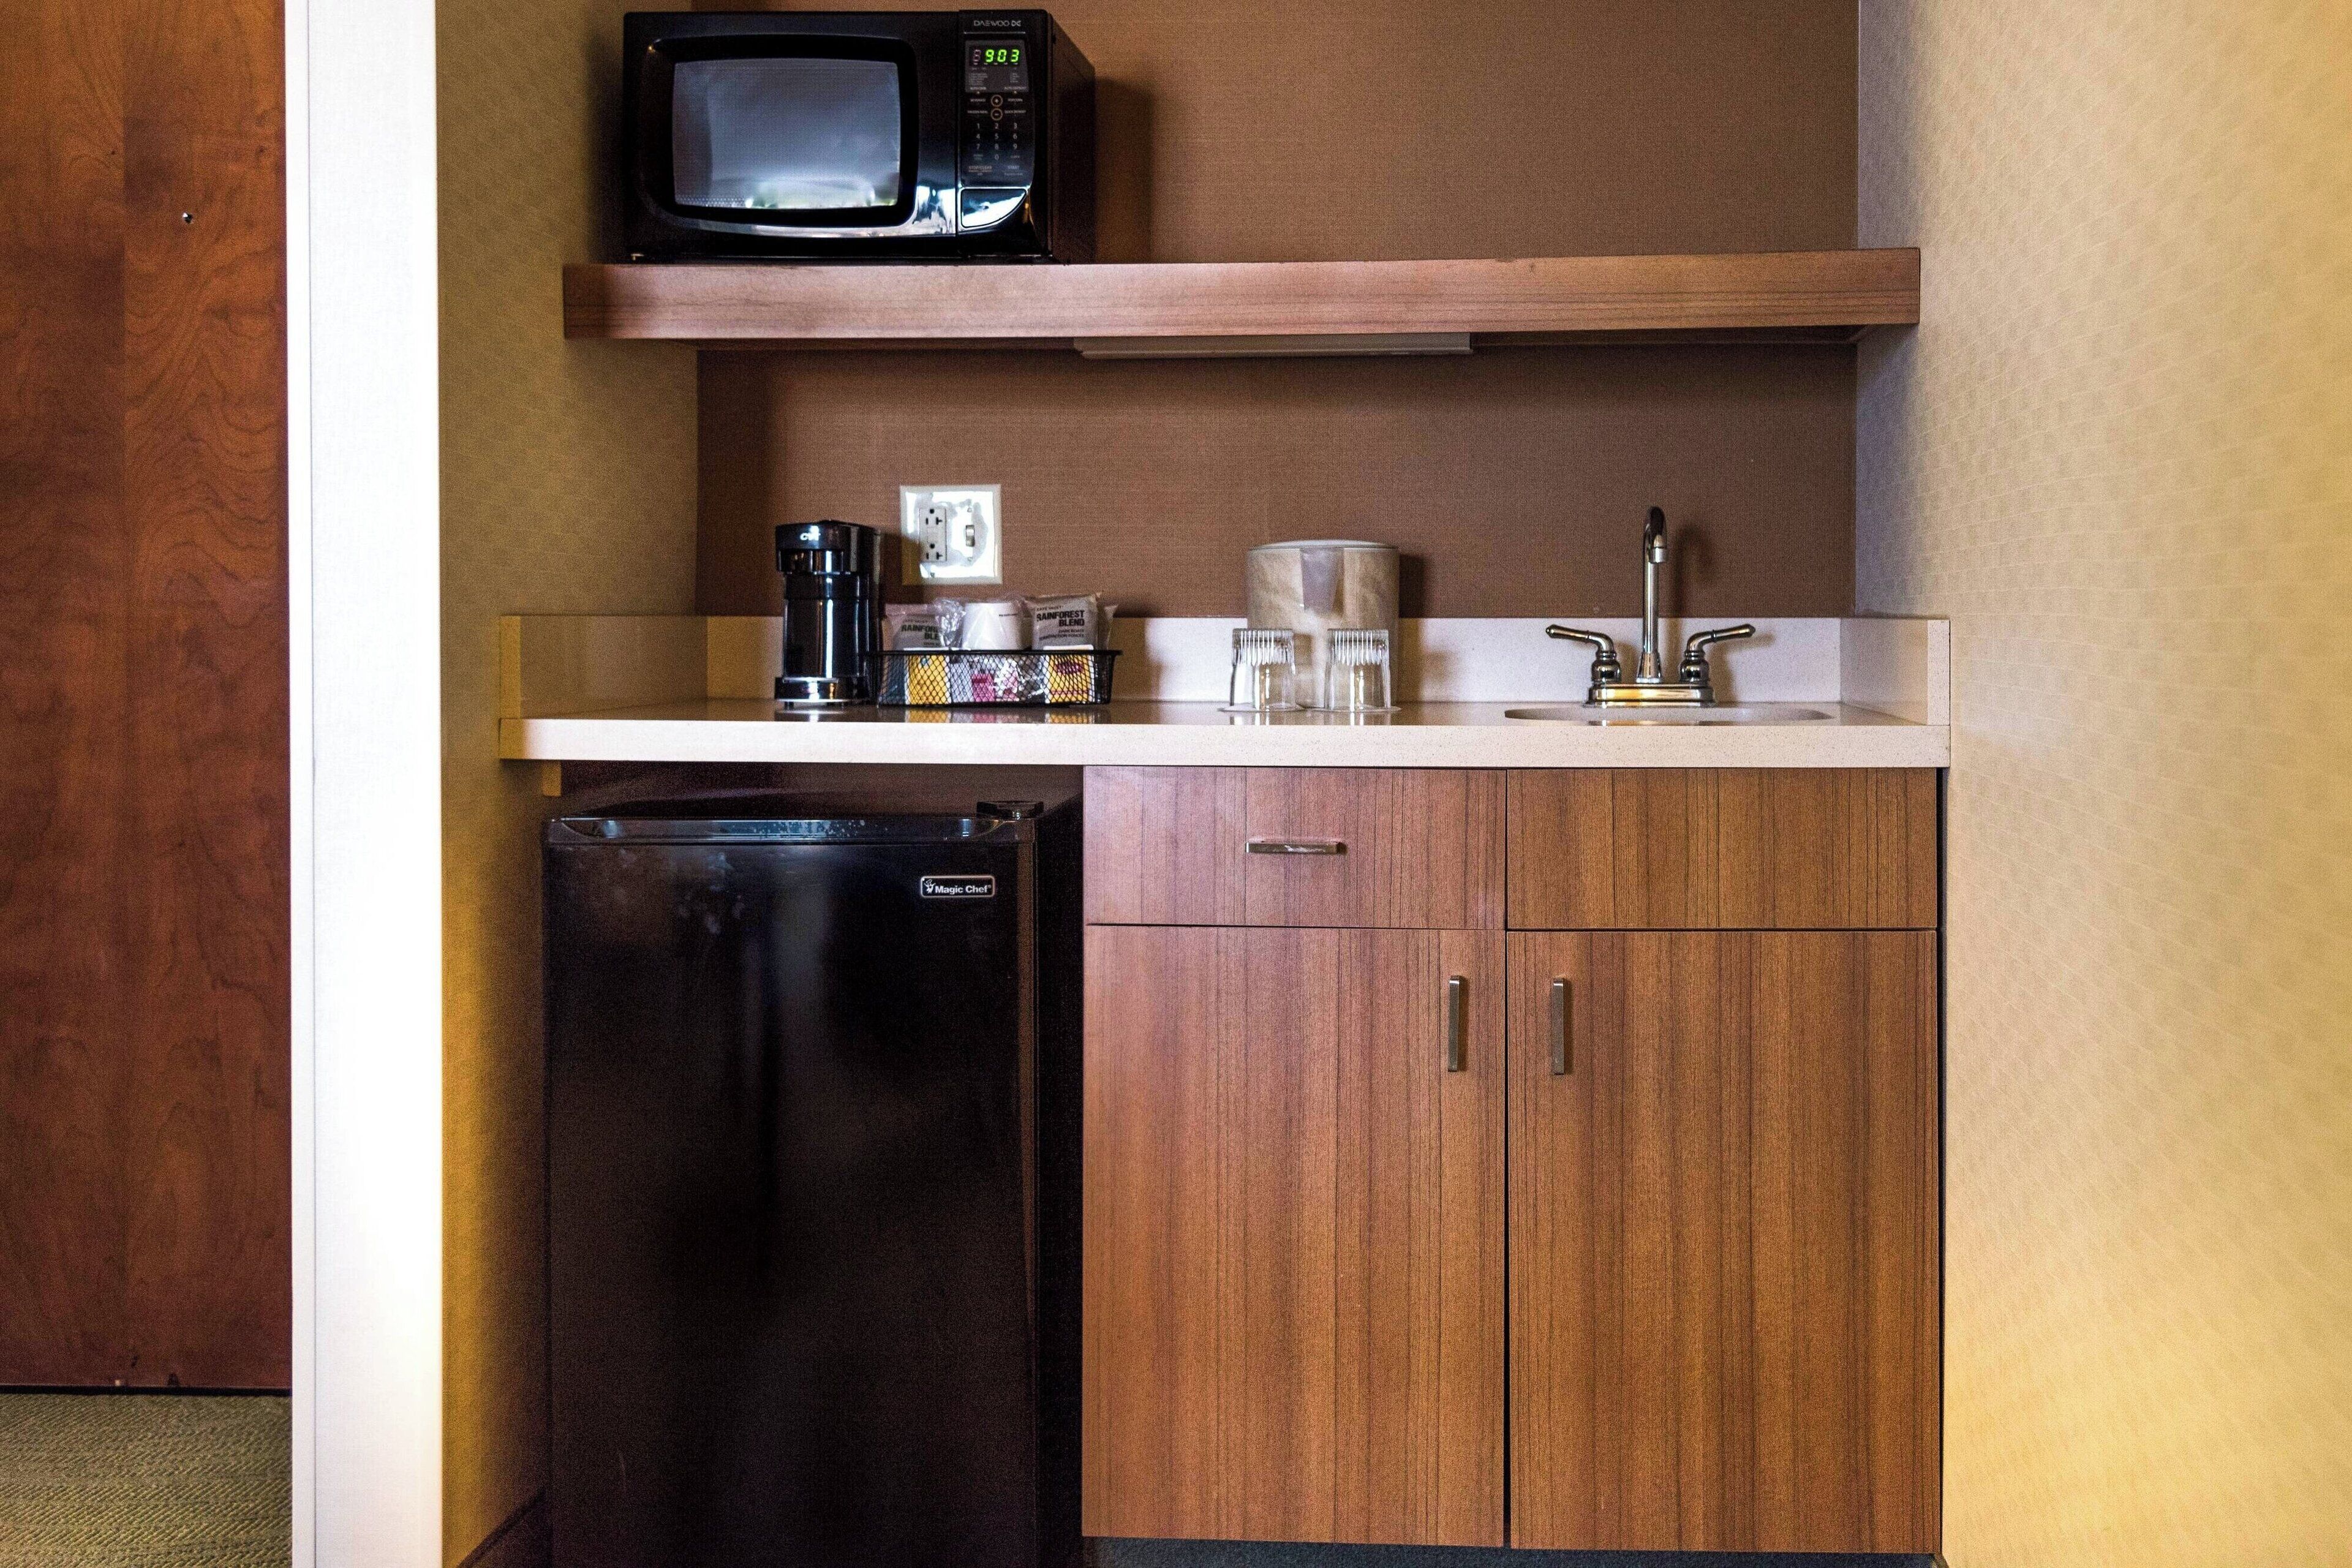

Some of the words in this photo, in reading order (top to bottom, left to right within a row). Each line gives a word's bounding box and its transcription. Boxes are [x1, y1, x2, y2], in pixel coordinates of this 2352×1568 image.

[1036, 610, 1085, 622] RAINFOREST
[1058, 618, 1085, 627] BLEND
[935, 885, 963, 894] Magic
